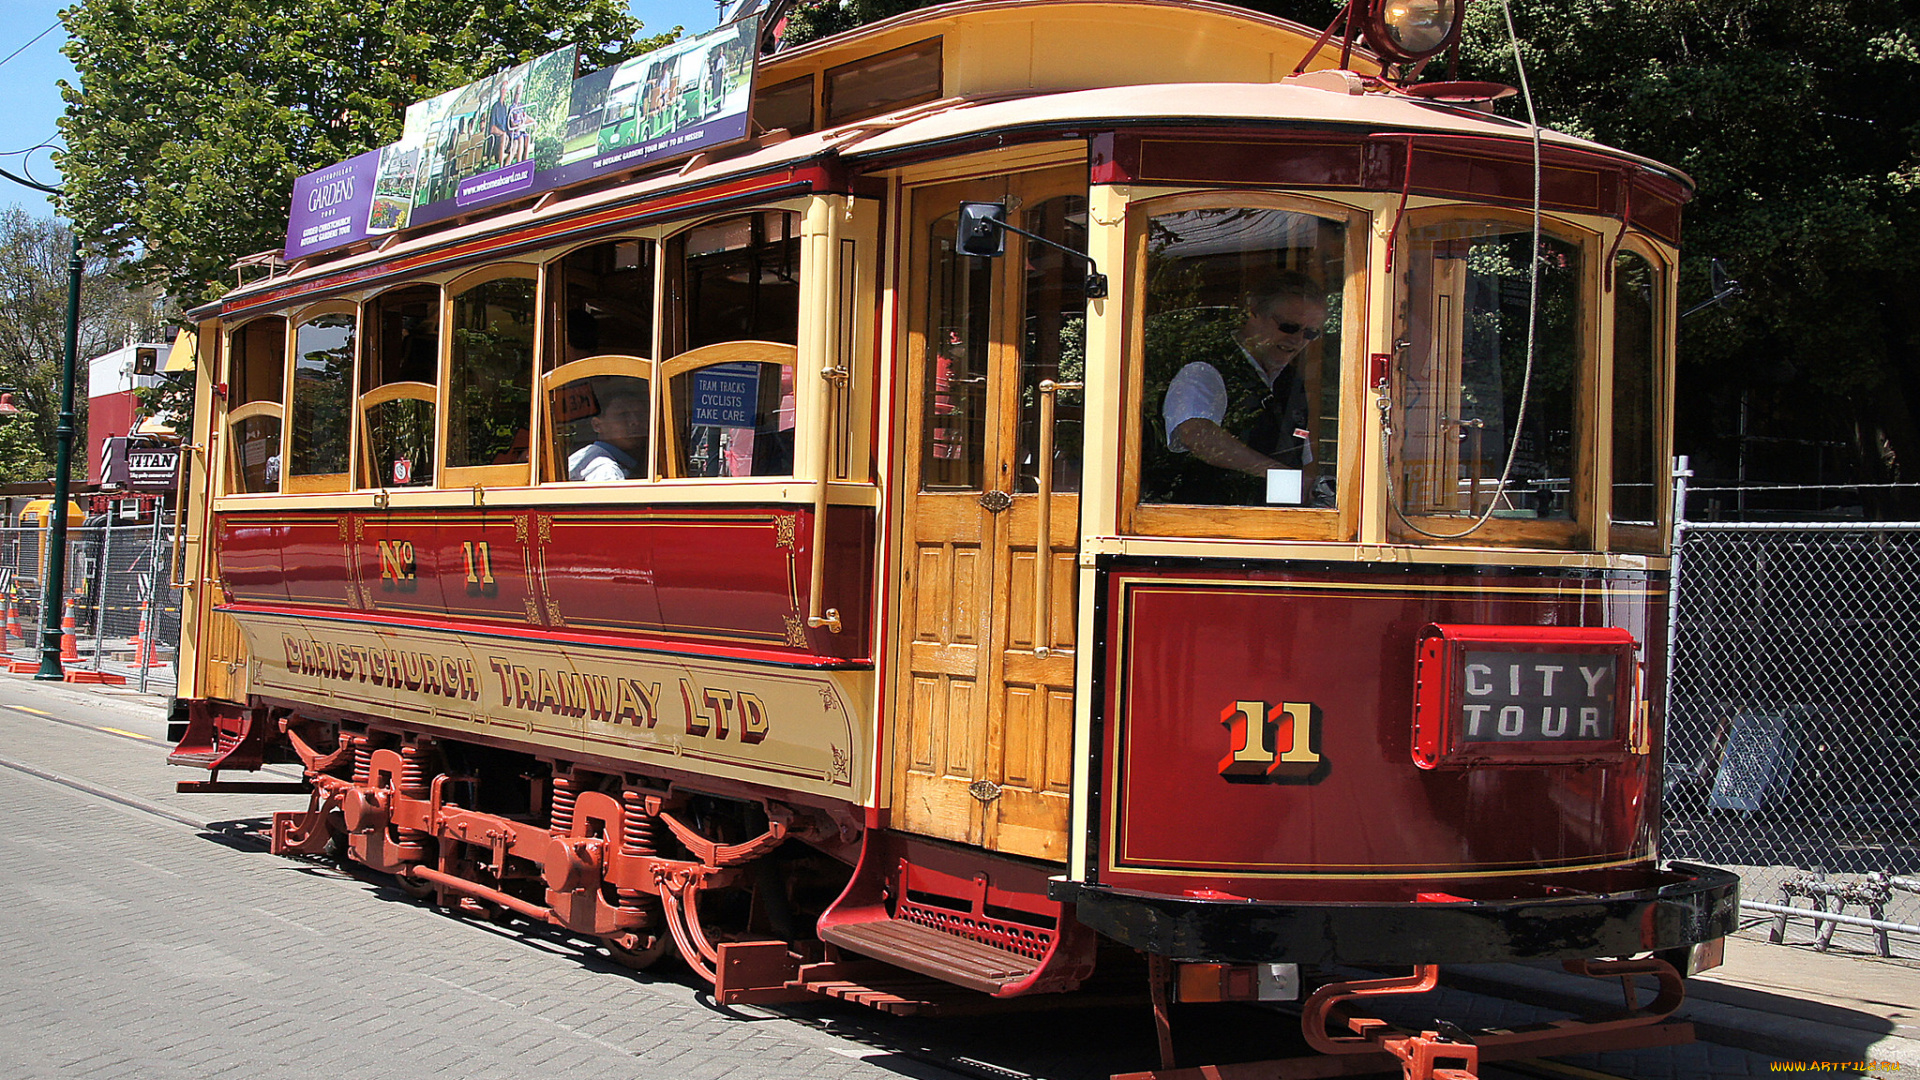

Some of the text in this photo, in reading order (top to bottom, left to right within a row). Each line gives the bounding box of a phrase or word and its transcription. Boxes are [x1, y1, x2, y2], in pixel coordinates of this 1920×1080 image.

[315, 165, 354, 185] CATERPILLAR
[308, 176, 356, 213] GARDENS
[320, 208, 337, 219] TOUR
[699, 379, 746, 394] TRAM TRACKS
[701, 394, 742, 408] CYCLISTS
[696, 408, 745, 422] TAKE CARE
[129, 453, 175, 469] TITAN
[461, 540, 497, 584] 11
[281, 632, 769, 745] CHRISTCHURCH TRAMWAY LTD
[1464, 663, 1608, 697] CITY
[1462, 704, 1600, 738] TOUR
[1219, 699, 1322, 777] 11
